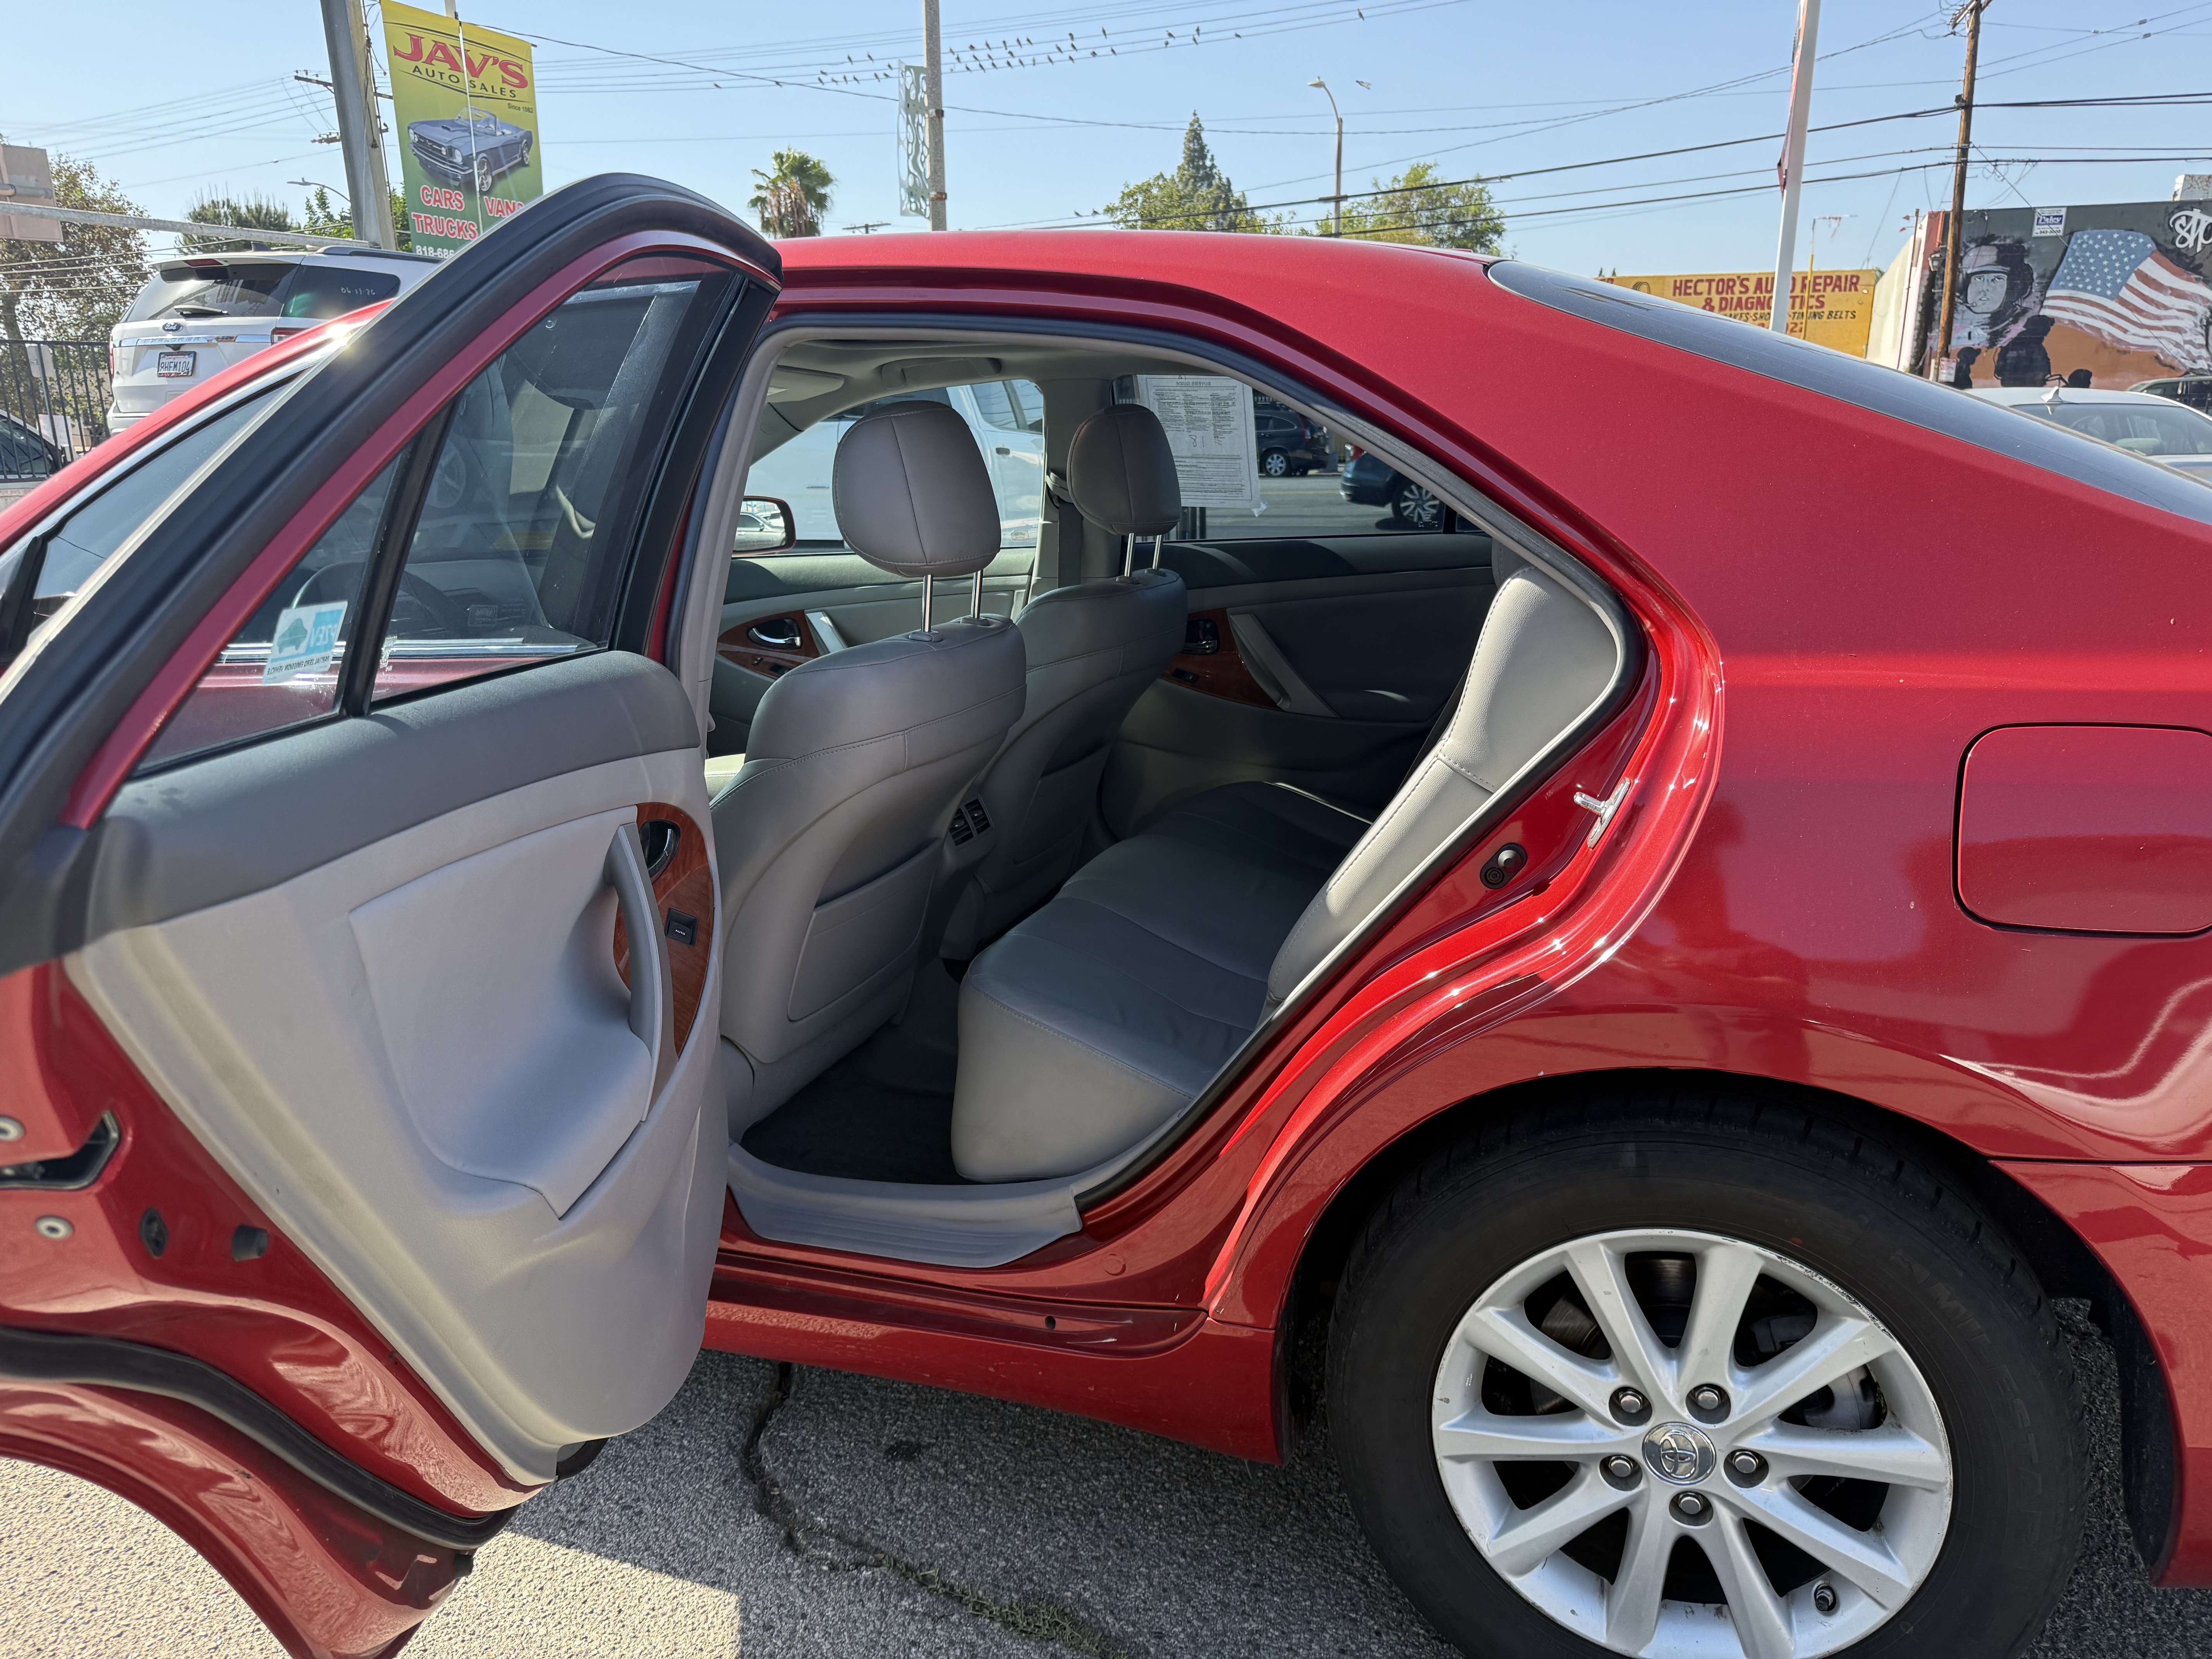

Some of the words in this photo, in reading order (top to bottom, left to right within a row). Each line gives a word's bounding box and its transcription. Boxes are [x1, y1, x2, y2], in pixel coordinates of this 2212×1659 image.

[393, 29, 528, 88] JAV'S
[412, 65, 460, 83] AUTO
[469, 80, 516, 98] SALES
[508, 103, 520, 111] Since
[421, 185, 465, 211] CARS
[411, 212, 479, 240] TRUCKS
[1673, 276, 1750, 297] HECTOR'S
[1753, 276, 1796, 295] AUO
[1800, 275, 1860, 293] REPAIR
[1702, 297, 1715, 313] &
[1718, 295, 1826, 313] DIAGNOTICS
[1827, 311, 1856, 319] BELTS
